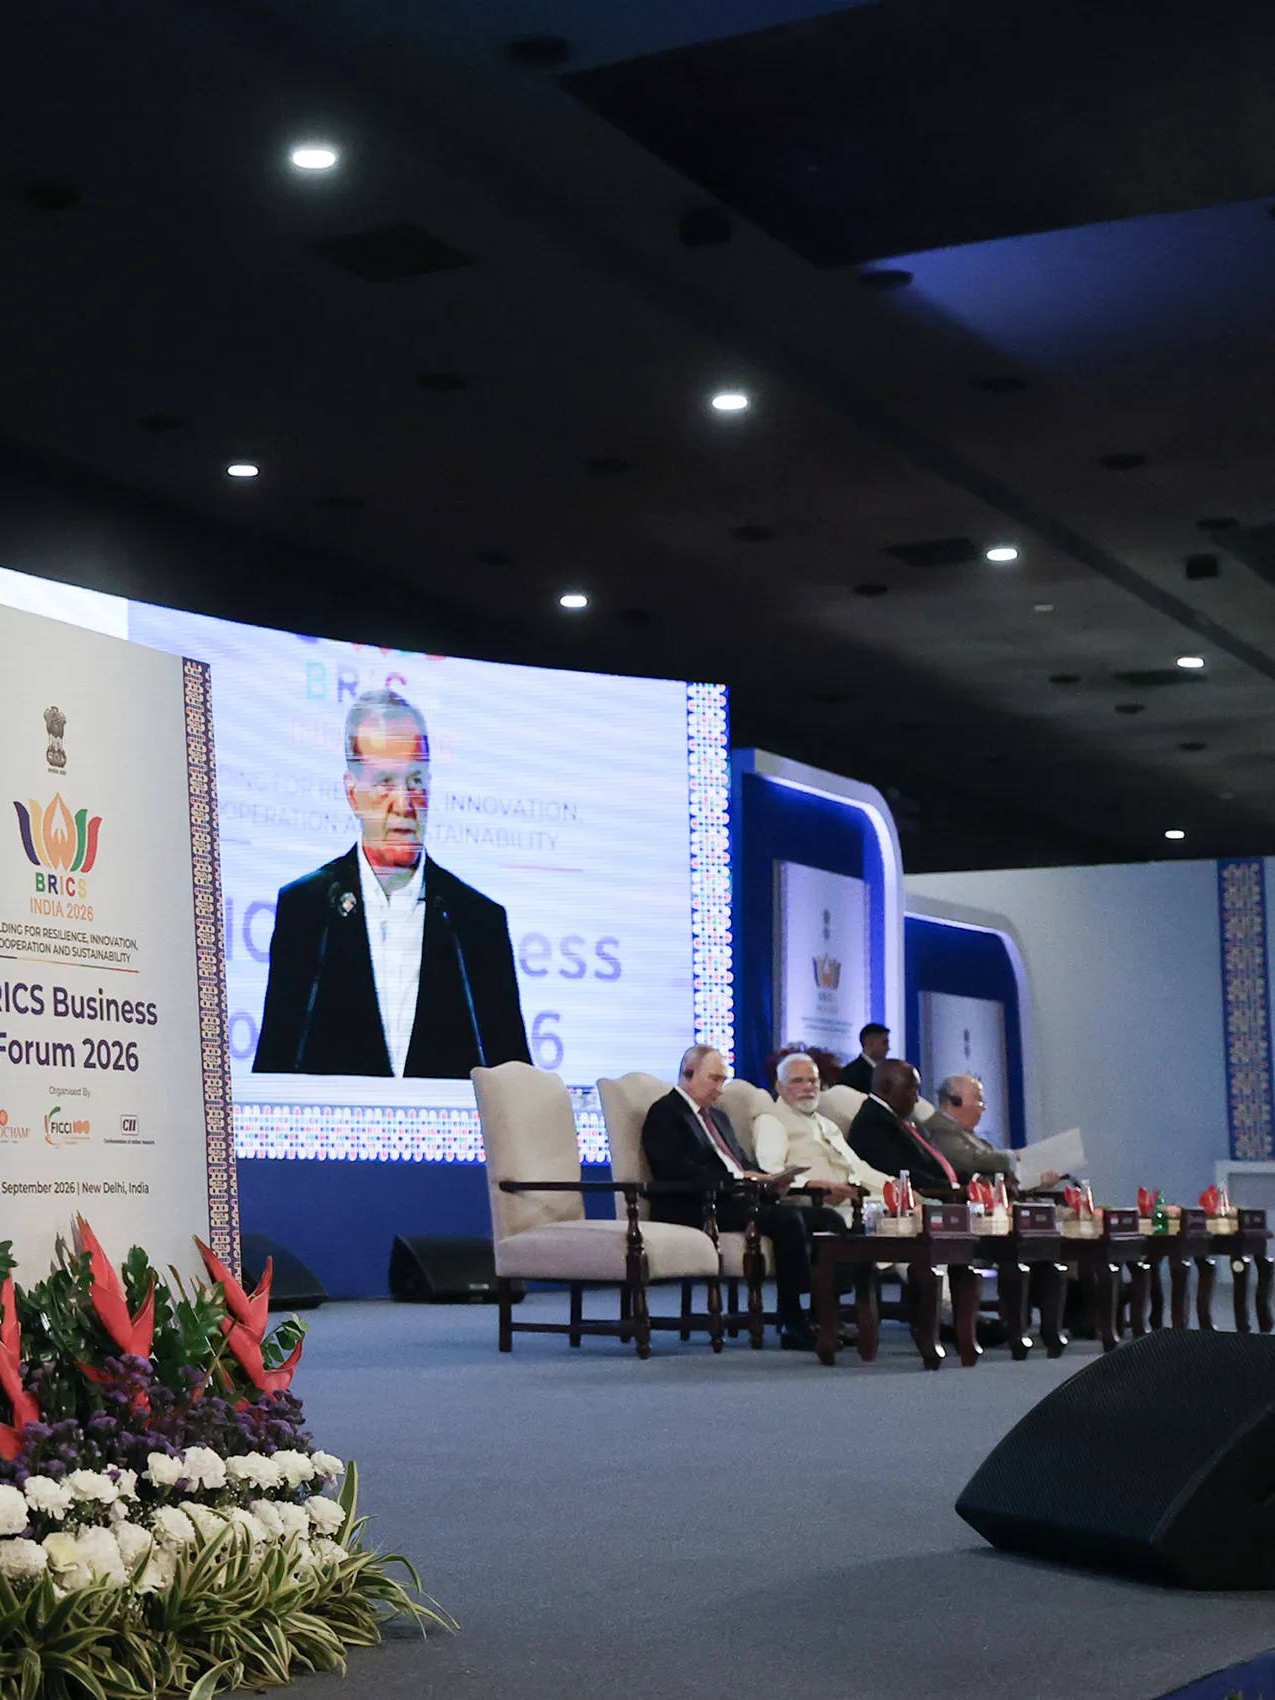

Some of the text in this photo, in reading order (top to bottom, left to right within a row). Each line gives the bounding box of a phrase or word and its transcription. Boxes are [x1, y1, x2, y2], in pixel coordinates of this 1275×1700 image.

[35, 872, 87, 899] BRICS
[30, 897, 94, 922] INDIA 2026
[25, 925, 41, 937] FOR
[42, 927, 89, 944] RESILIENCE,
[90, 933, 139, 951] INNOVATION,
[53, 945, 71, 956] AND
[72, 946, 131, 963] SUSTAINABILITY
[52, 986, 158, 1026] Business
[82, 1037, 139, 1073] 2026
[48, 1085, 91, 1098] Organised By
[51, 1121, 72, 1134] FICCI
[122, 1118, 137, 1132] CII
[1, 1181, 52, 1196] September
[54, 1181, 76, 1194] 2026
[82, 1182, 101, 1194] New
[103, 1181, 127, 1195] Delhi,
[128, 1182, 150, 1194] India
